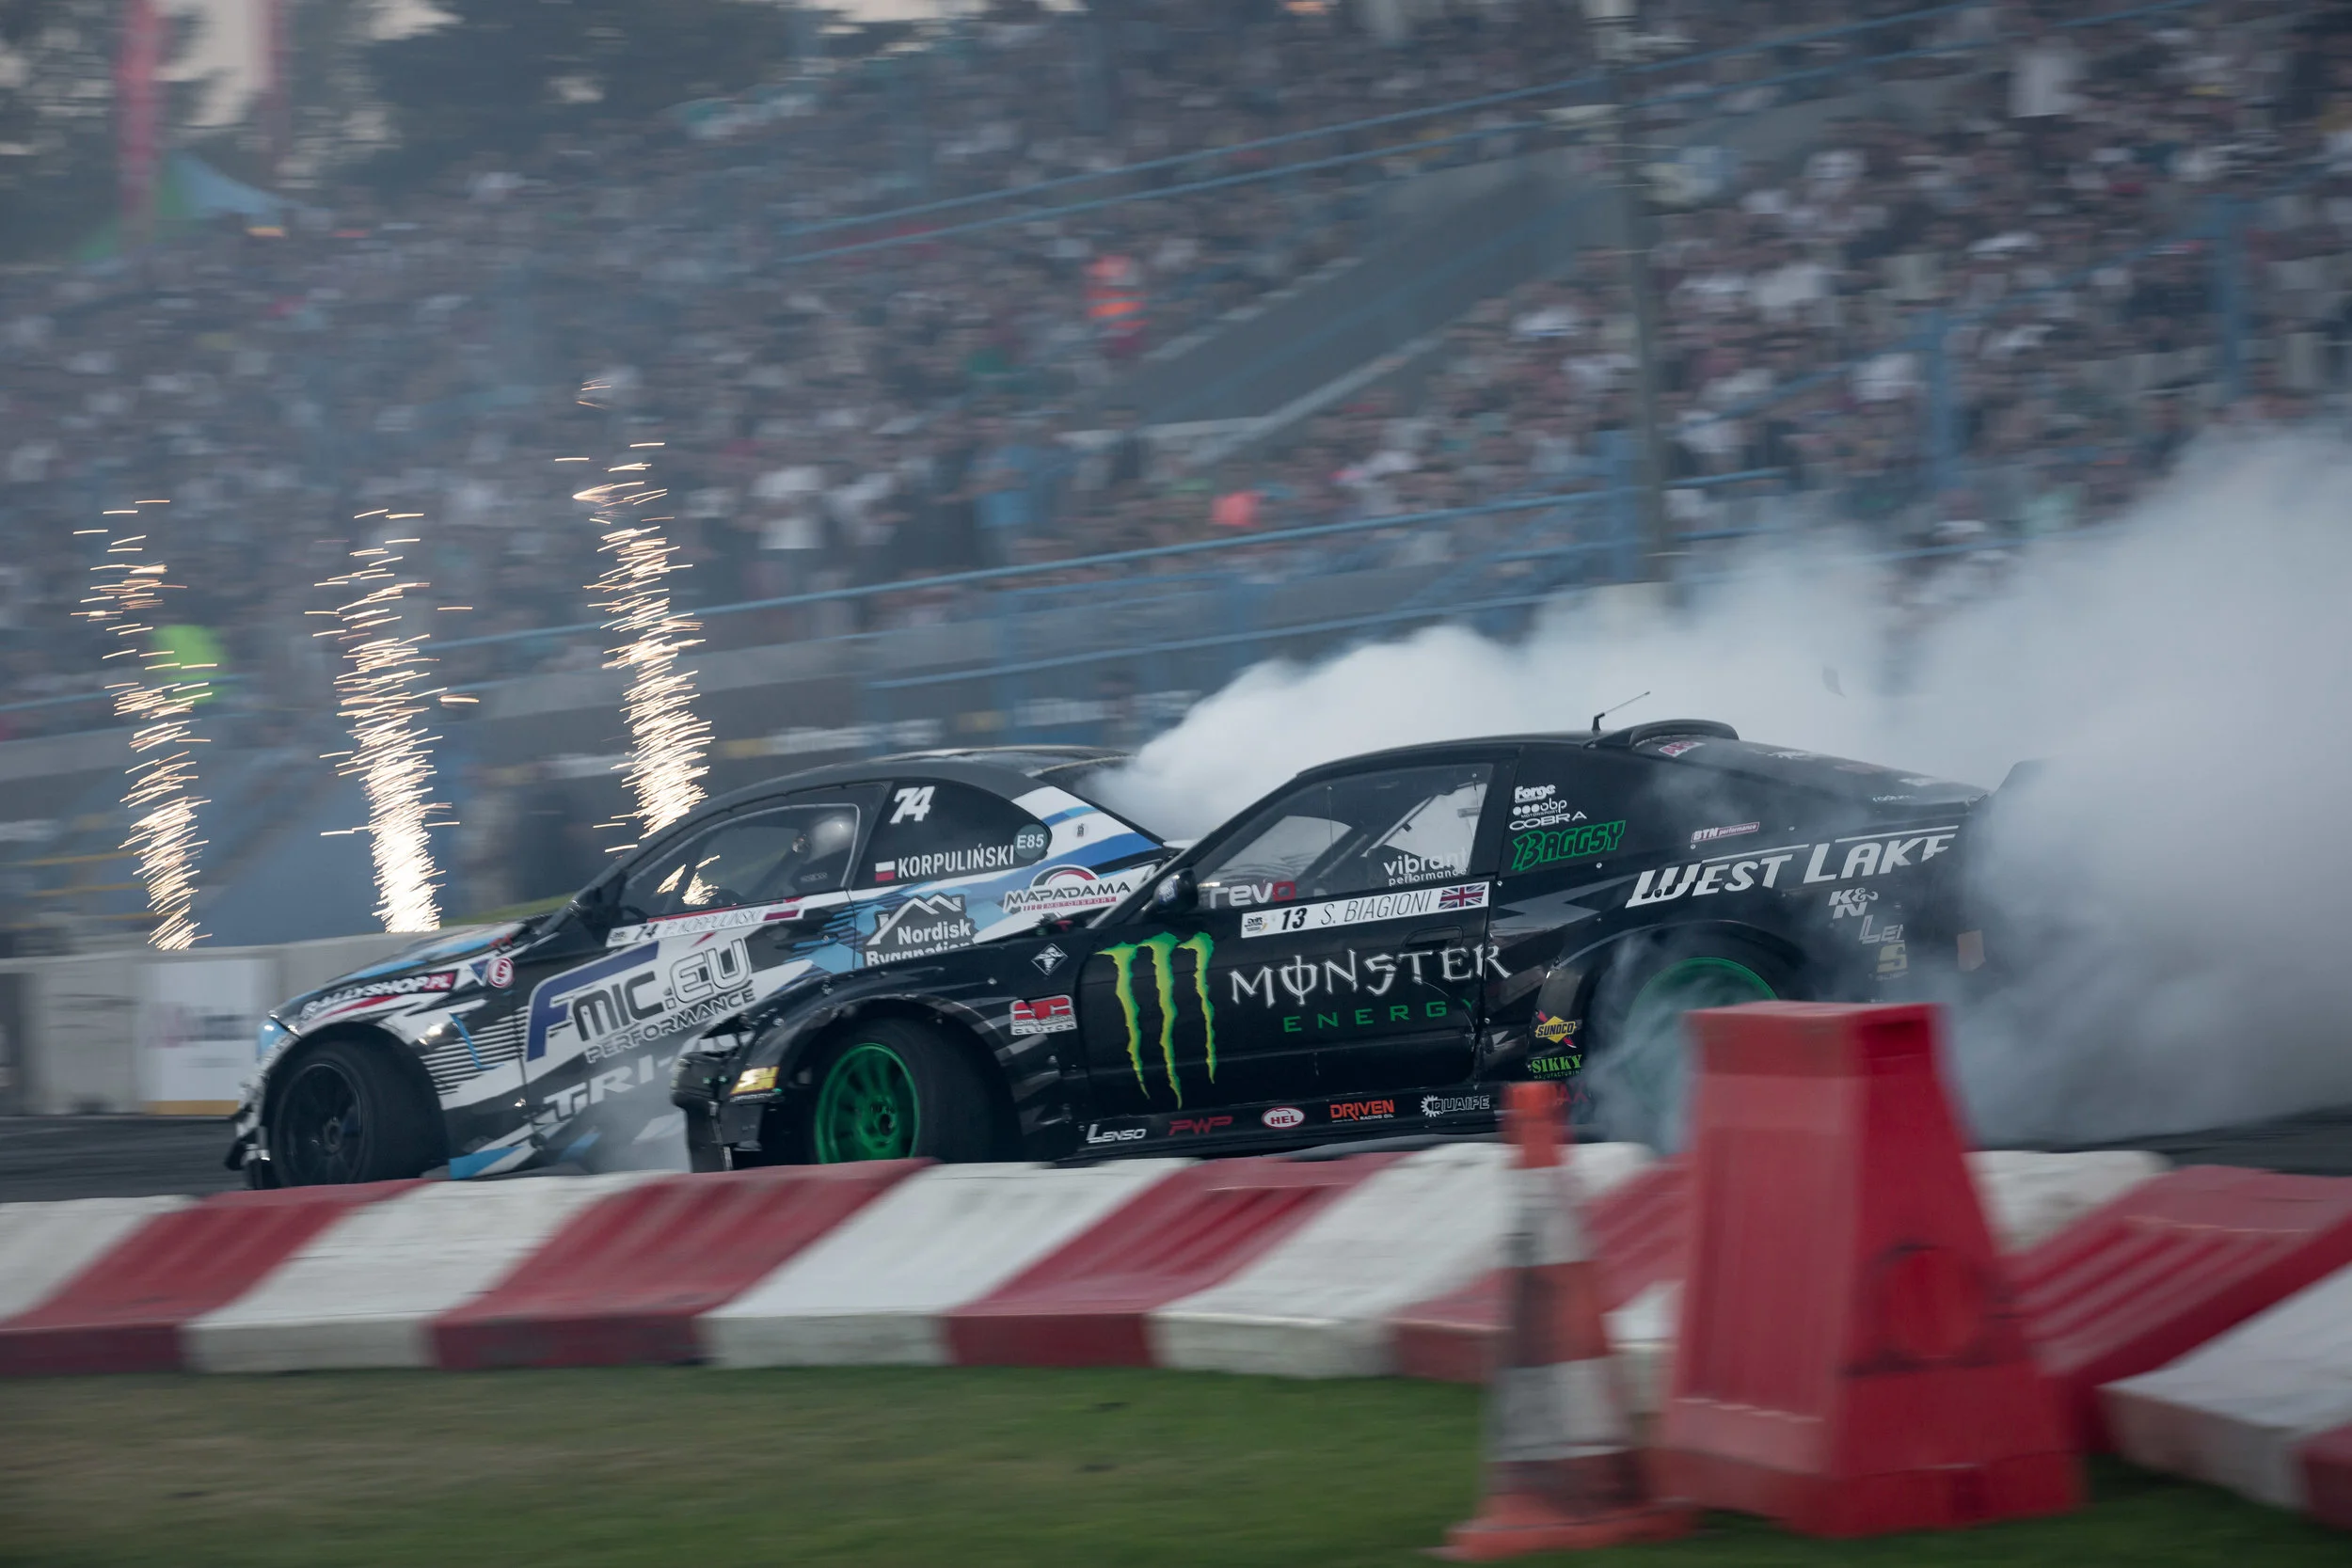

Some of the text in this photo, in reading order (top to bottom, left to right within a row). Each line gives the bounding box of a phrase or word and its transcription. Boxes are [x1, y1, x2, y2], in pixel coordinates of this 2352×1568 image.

[890, 785, 936, 824] 74
[1540, 798, 1567, 814] obp
[1509, 811, 1588, 831] COBRA
[1719, 824, 1757, 836] performance
[1016, 833, 1045, 850] E85
[1511, 820, 1627, 872] BAGGSY
[898, 843, 1015, 879] KORPULIŃSKI
[1383, 847, 1468, 877] vibrant
[1625, 833, 1956, 909] WEST LAKE
[1389, 867, 1468, 886] performance
[1006, 881, 1132, 908] MAPADAMA
[1208, 880, 1296, 909] revo
[1282, 907, 1308, 930] 13
[1320, 903, 1337, 926] S.
[1343, 891, 1433, 923] BIAGIONI
[897, 918, 972, 945] Nordisk
[1227, 943, 1513, 1008] MONSTER
[583, 987, 756, 1064] PERFORMANCE
[1537, 1022, 1575, 1036] SUNOCO
[1531, 1053, 1582, 1073] SIKKY
[1329, 1099, 1395, 1121] DRIVEN
[1427, 1094, 1490, 1114] QUAIFE
[1168, 1116, 1234, 1136] PWP
[1270, 1116, 1299, 1126] HEL
[1086, 1123, 1147, 1144] LENSO
